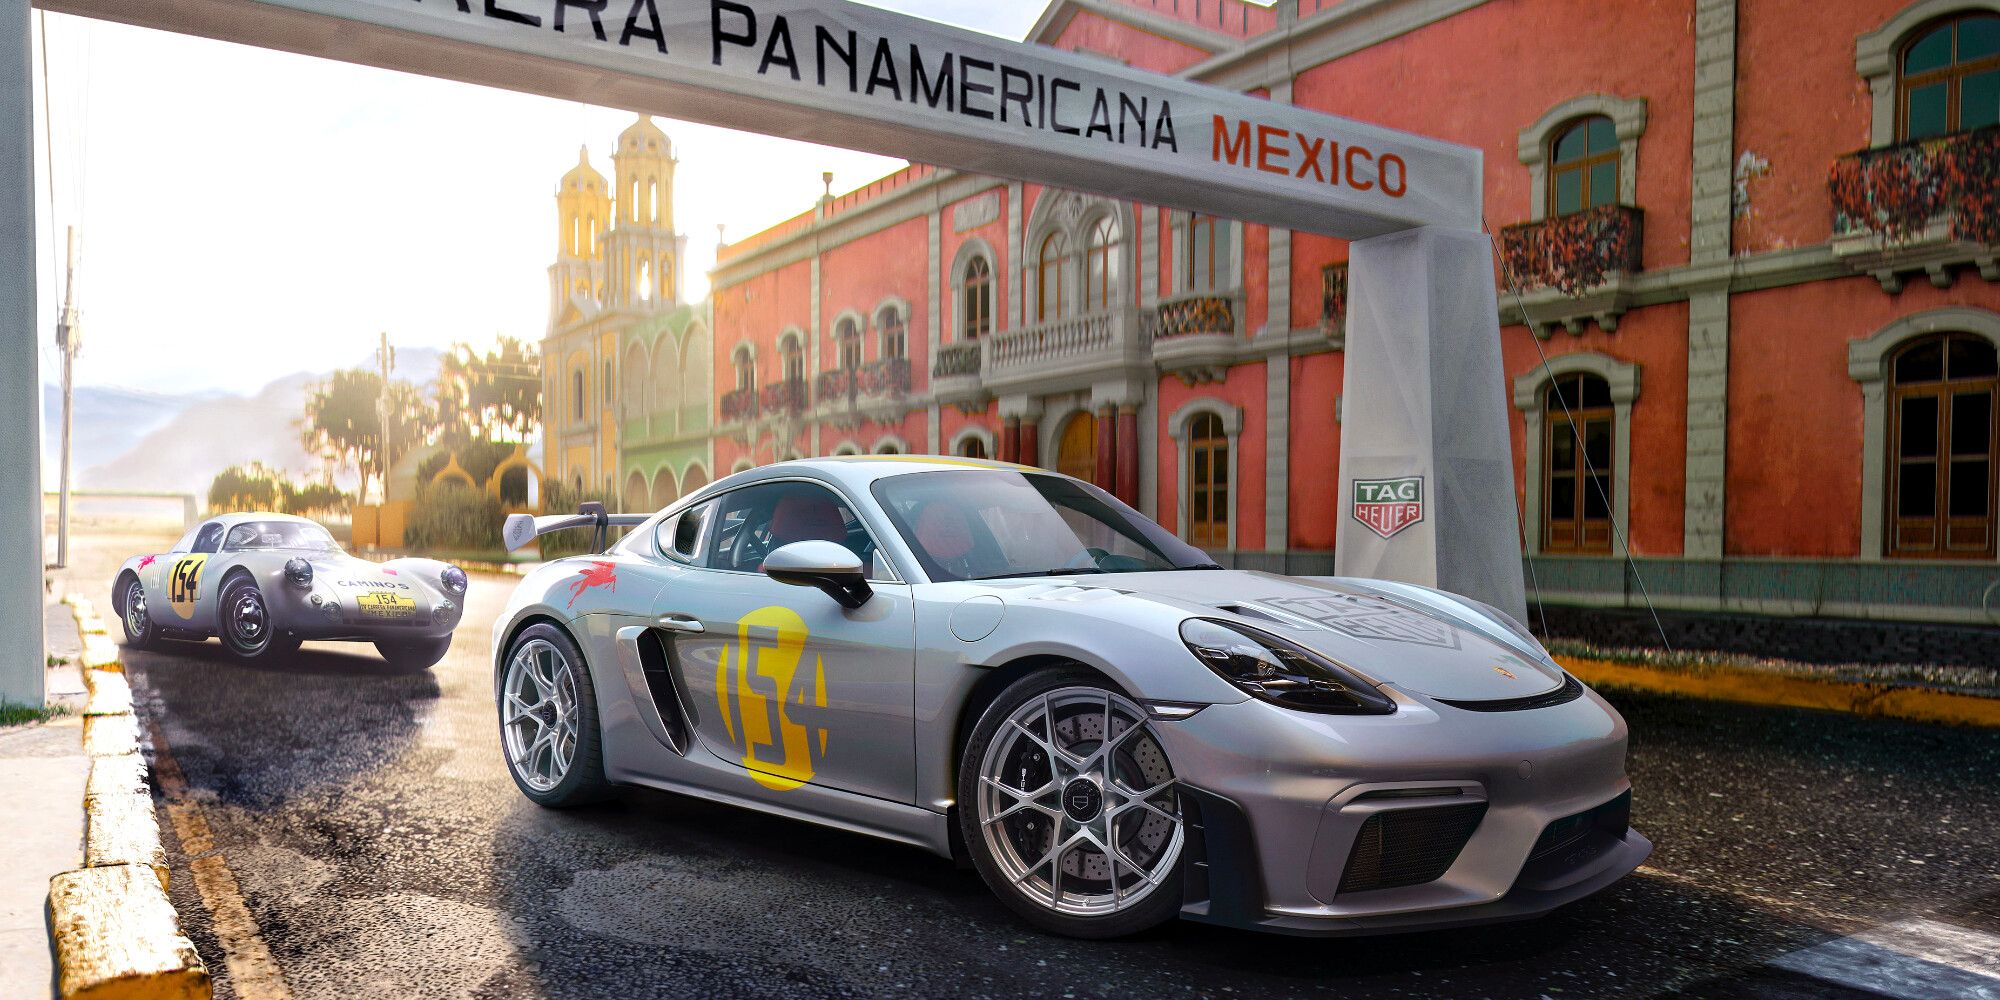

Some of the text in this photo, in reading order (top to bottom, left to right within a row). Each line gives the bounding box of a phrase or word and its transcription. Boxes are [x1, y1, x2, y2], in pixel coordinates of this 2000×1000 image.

[710, 0, 1178, 153] PANAMERICANA
[1212, 114, 1407, 198] MEXICO
[1360, 482, 1415, 501] TAG
[1358, 505, 1417, 533] HEUER
[171, 560, 204, 603] 154
[376, 594, 397, 605] 154
[726, 622, 828, 773] 154
